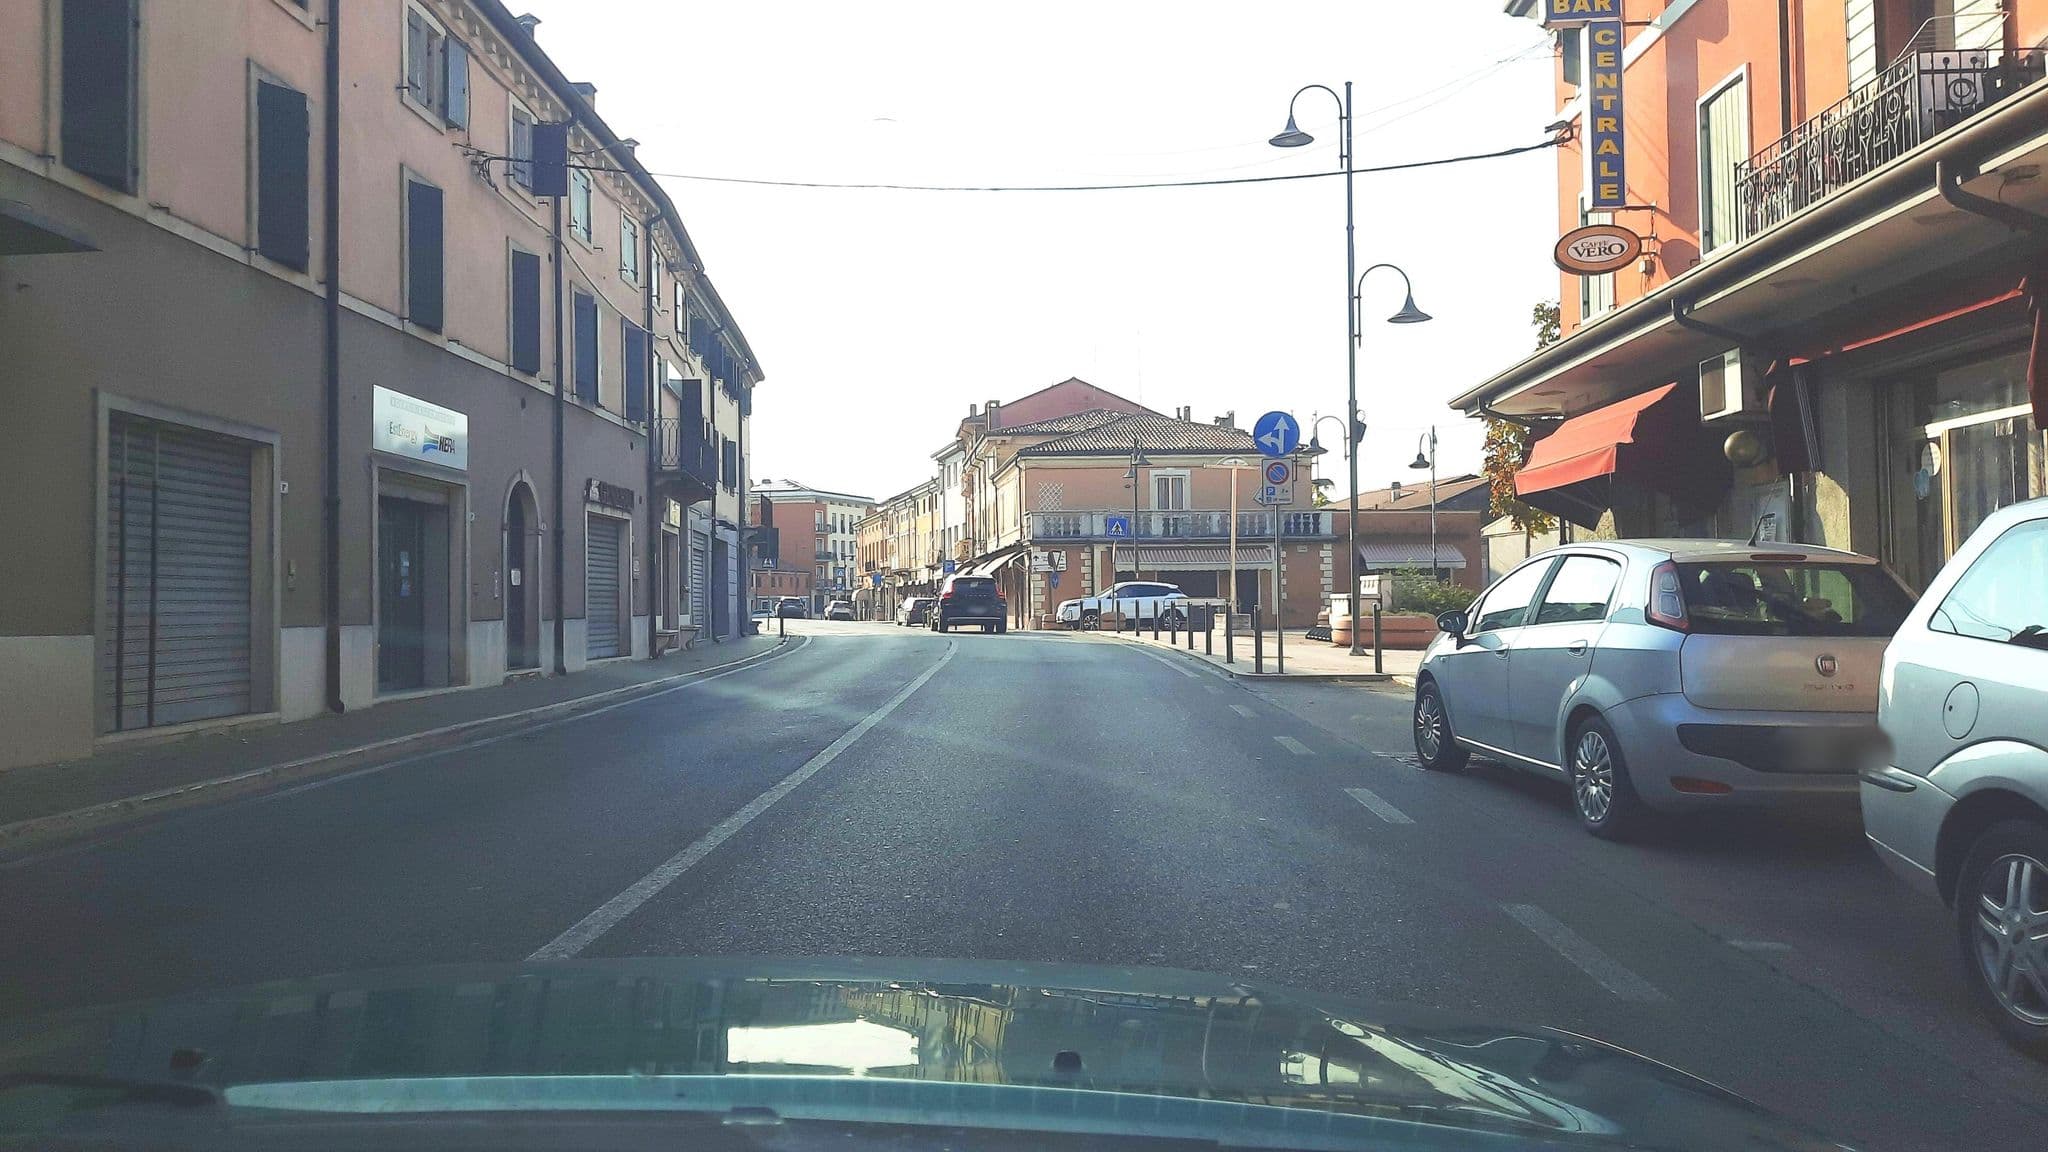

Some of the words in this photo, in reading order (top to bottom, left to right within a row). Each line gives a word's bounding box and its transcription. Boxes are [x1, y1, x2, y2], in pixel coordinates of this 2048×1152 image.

[1554, 0, 1612, 14] BAR
[1595, 29, 1619, 200] CENTRALE
[1572, 242, 1625, 257] VERO
